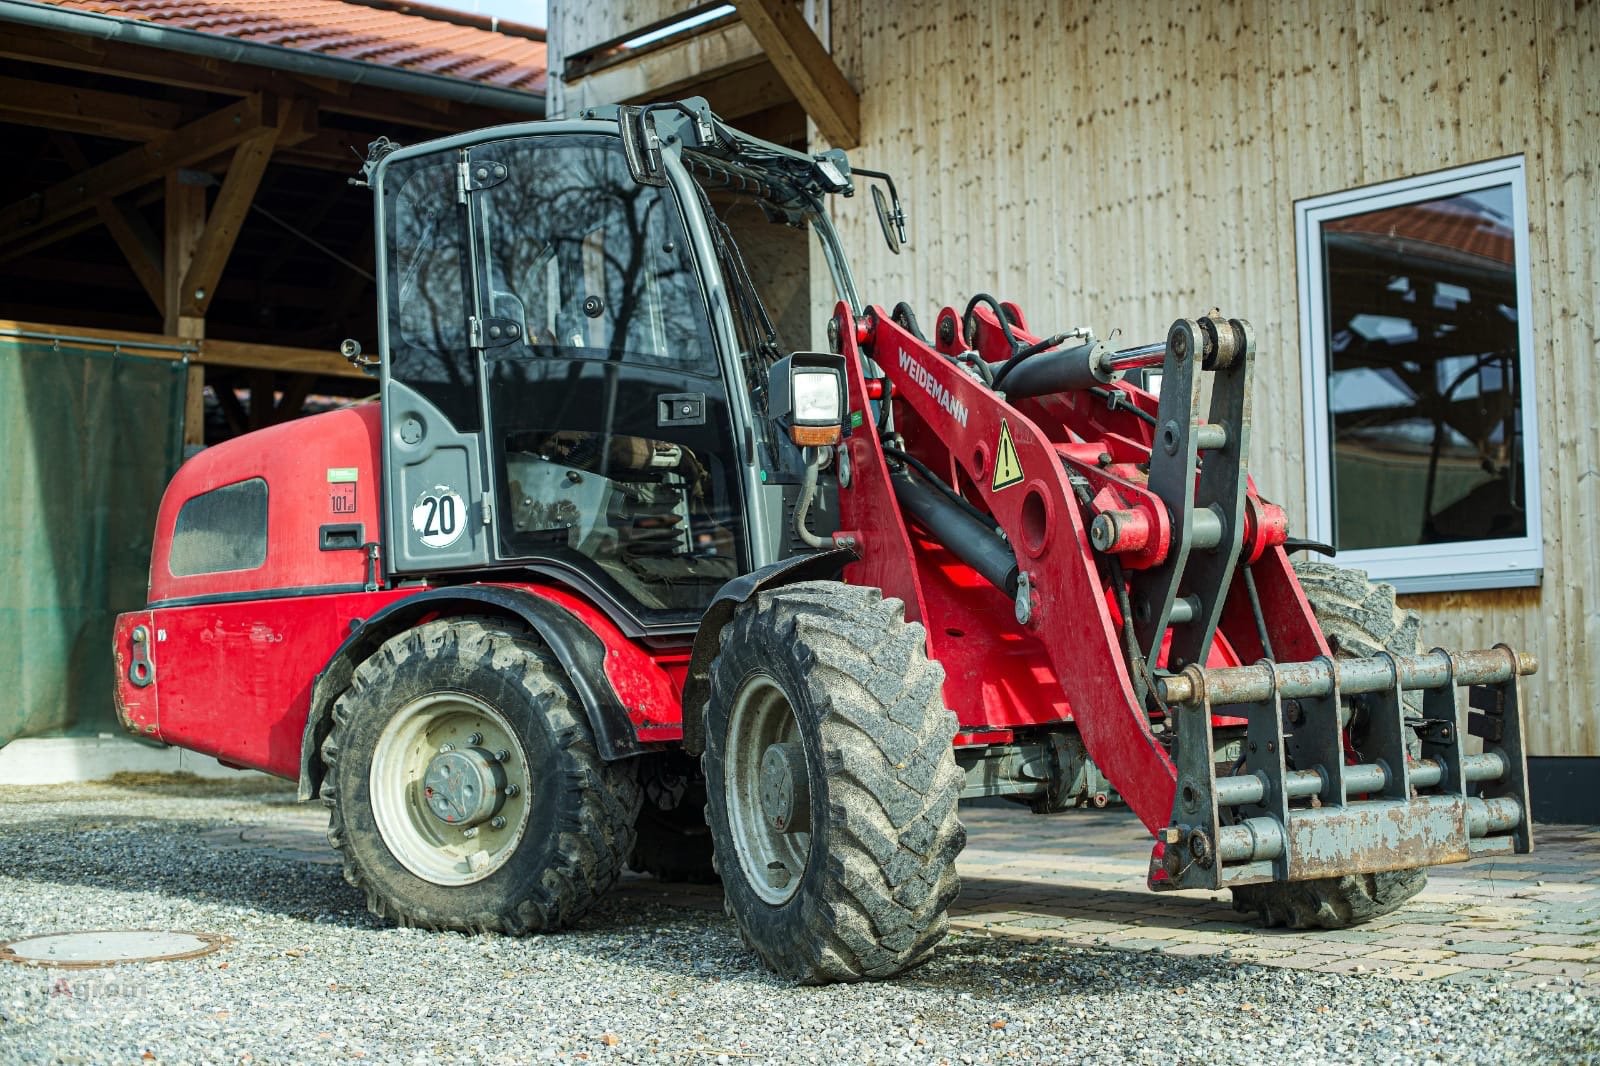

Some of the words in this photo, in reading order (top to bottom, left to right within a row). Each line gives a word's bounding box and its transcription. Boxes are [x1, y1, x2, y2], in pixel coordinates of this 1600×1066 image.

[898, 347, 969, 428] WEIDEMANN
[331, 495, 347, 511] 101
[422, 495, 456, 537] 20
